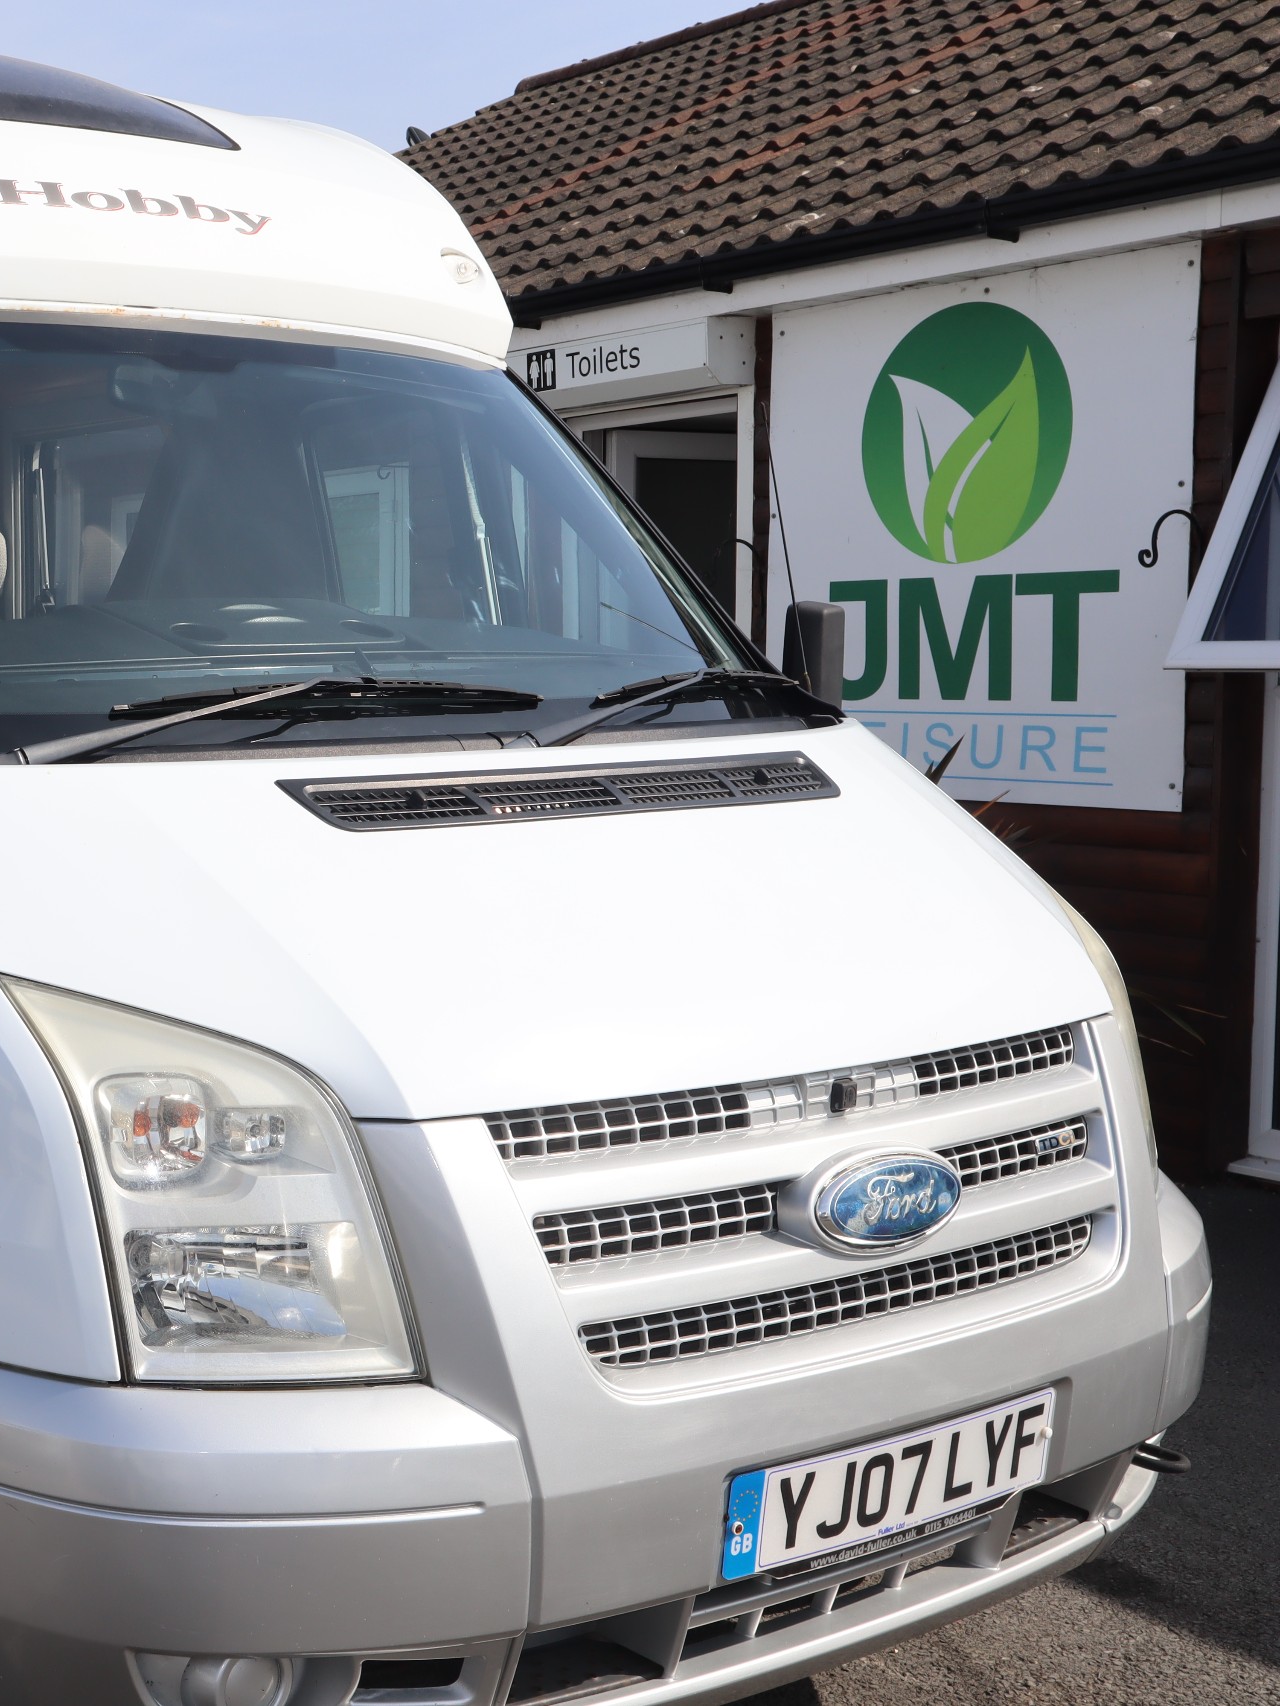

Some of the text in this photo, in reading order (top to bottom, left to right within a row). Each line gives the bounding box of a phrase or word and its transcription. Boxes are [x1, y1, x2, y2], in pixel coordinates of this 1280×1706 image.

[565, 344, 640, 378] Toilets
[829, 569, 1120, 702] JMT
[860, 721, 1108, 774] ISURE
[863, 1172, 937, 1226] Ford
[780, 1403, 1046, 1550] YJ07 LYF
[730, 1533, 753, 1556] GB
[809, 1528, 917, 1569] www.david-fuller.co.uk
[924, 1520, 942, 1534] 0115
[877, 1525, 895, 1537] Fuller
[895, 1521, 906, 1531] Ltd
